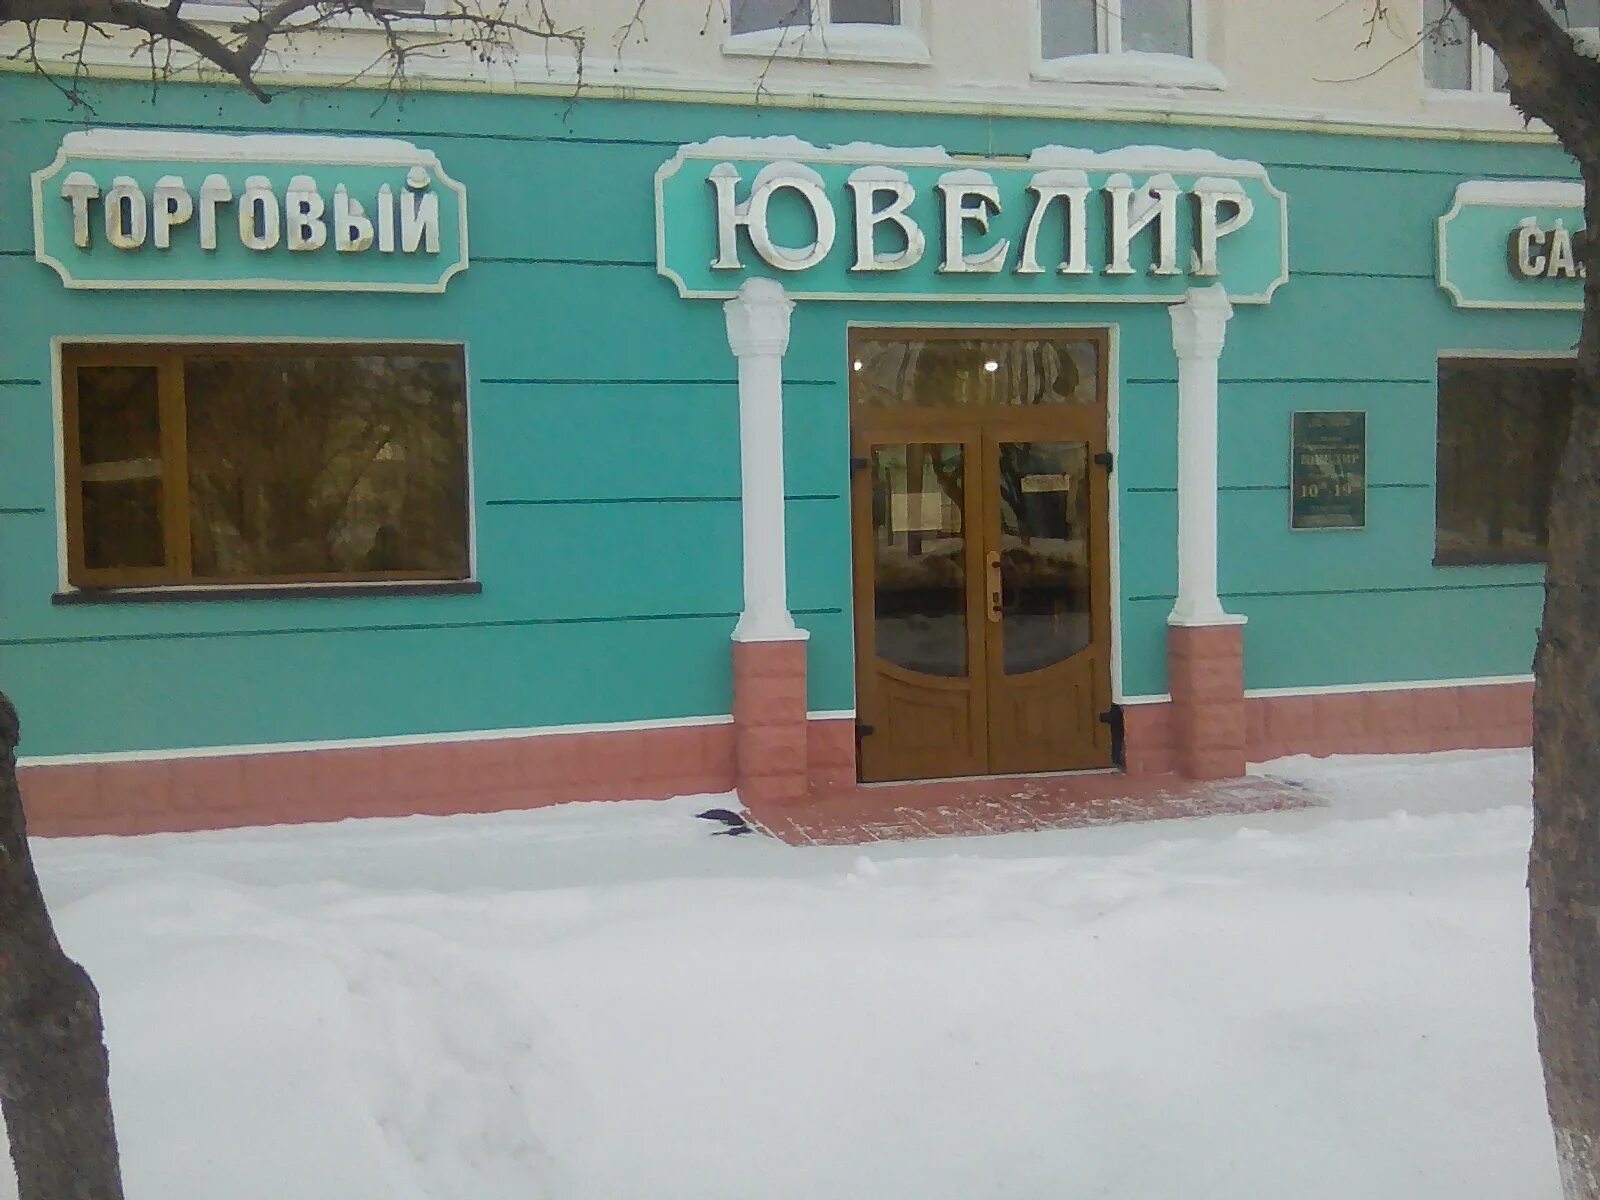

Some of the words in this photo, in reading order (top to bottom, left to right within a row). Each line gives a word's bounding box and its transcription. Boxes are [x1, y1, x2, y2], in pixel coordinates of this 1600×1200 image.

[62, 172, 441, 254] ТОРГОВЫЙ
[707, 164, 1254, 276] ЮВЕЛИР
[1518, 222, 1587, 279] СА
